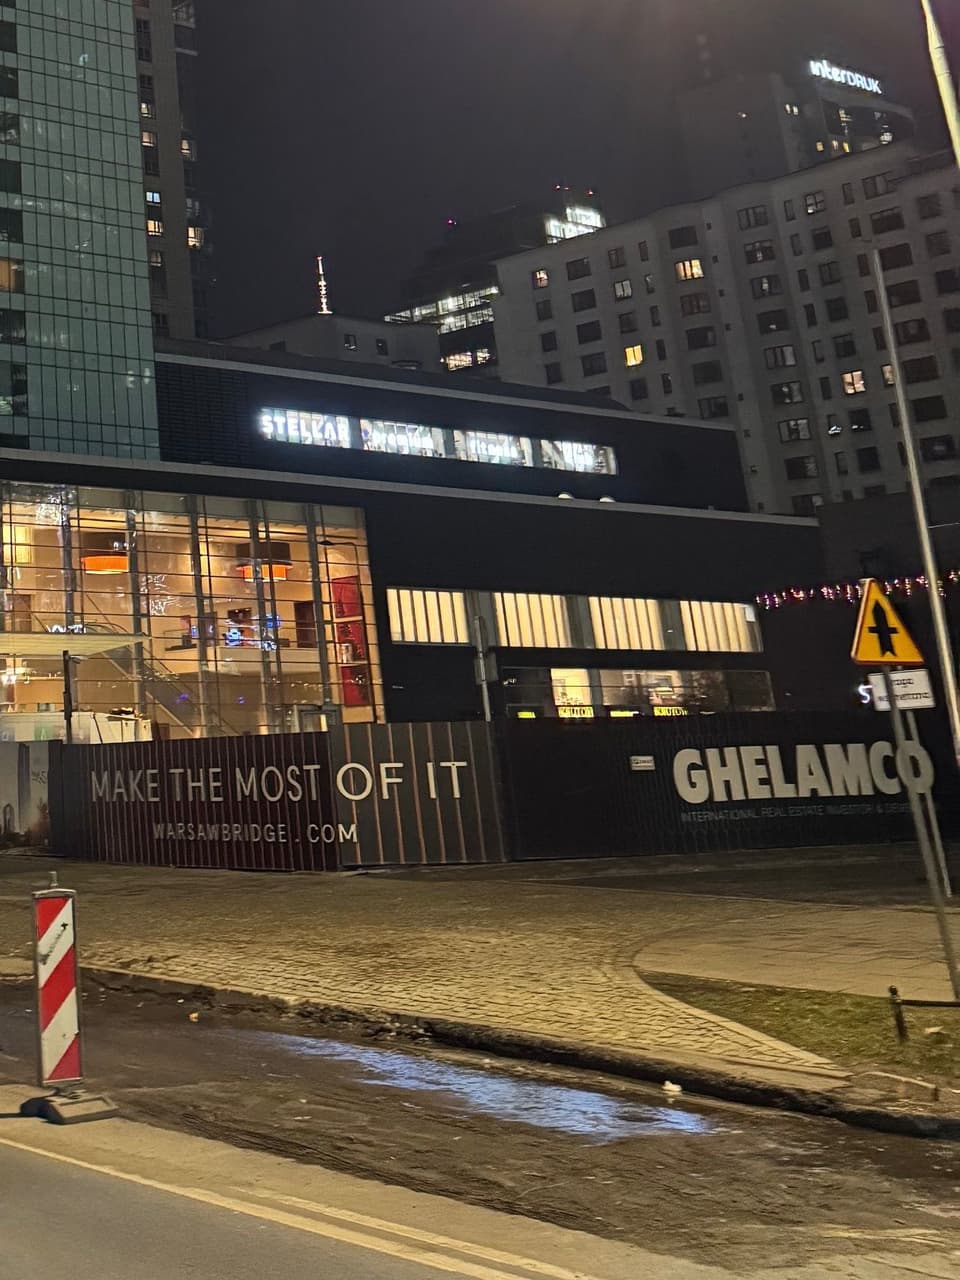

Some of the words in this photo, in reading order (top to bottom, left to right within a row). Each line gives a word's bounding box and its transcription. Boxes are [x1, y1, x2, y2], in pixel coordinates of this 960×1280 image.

[260, 414, 350, 439] STELLAR
[91, 769, 160, 802] MAKE
[169, 767, 224, 802] THE
[235, 764, 321, 802] MOST
[336, 762, 404, 801] OF
[427, 761, 468, 800] IT
